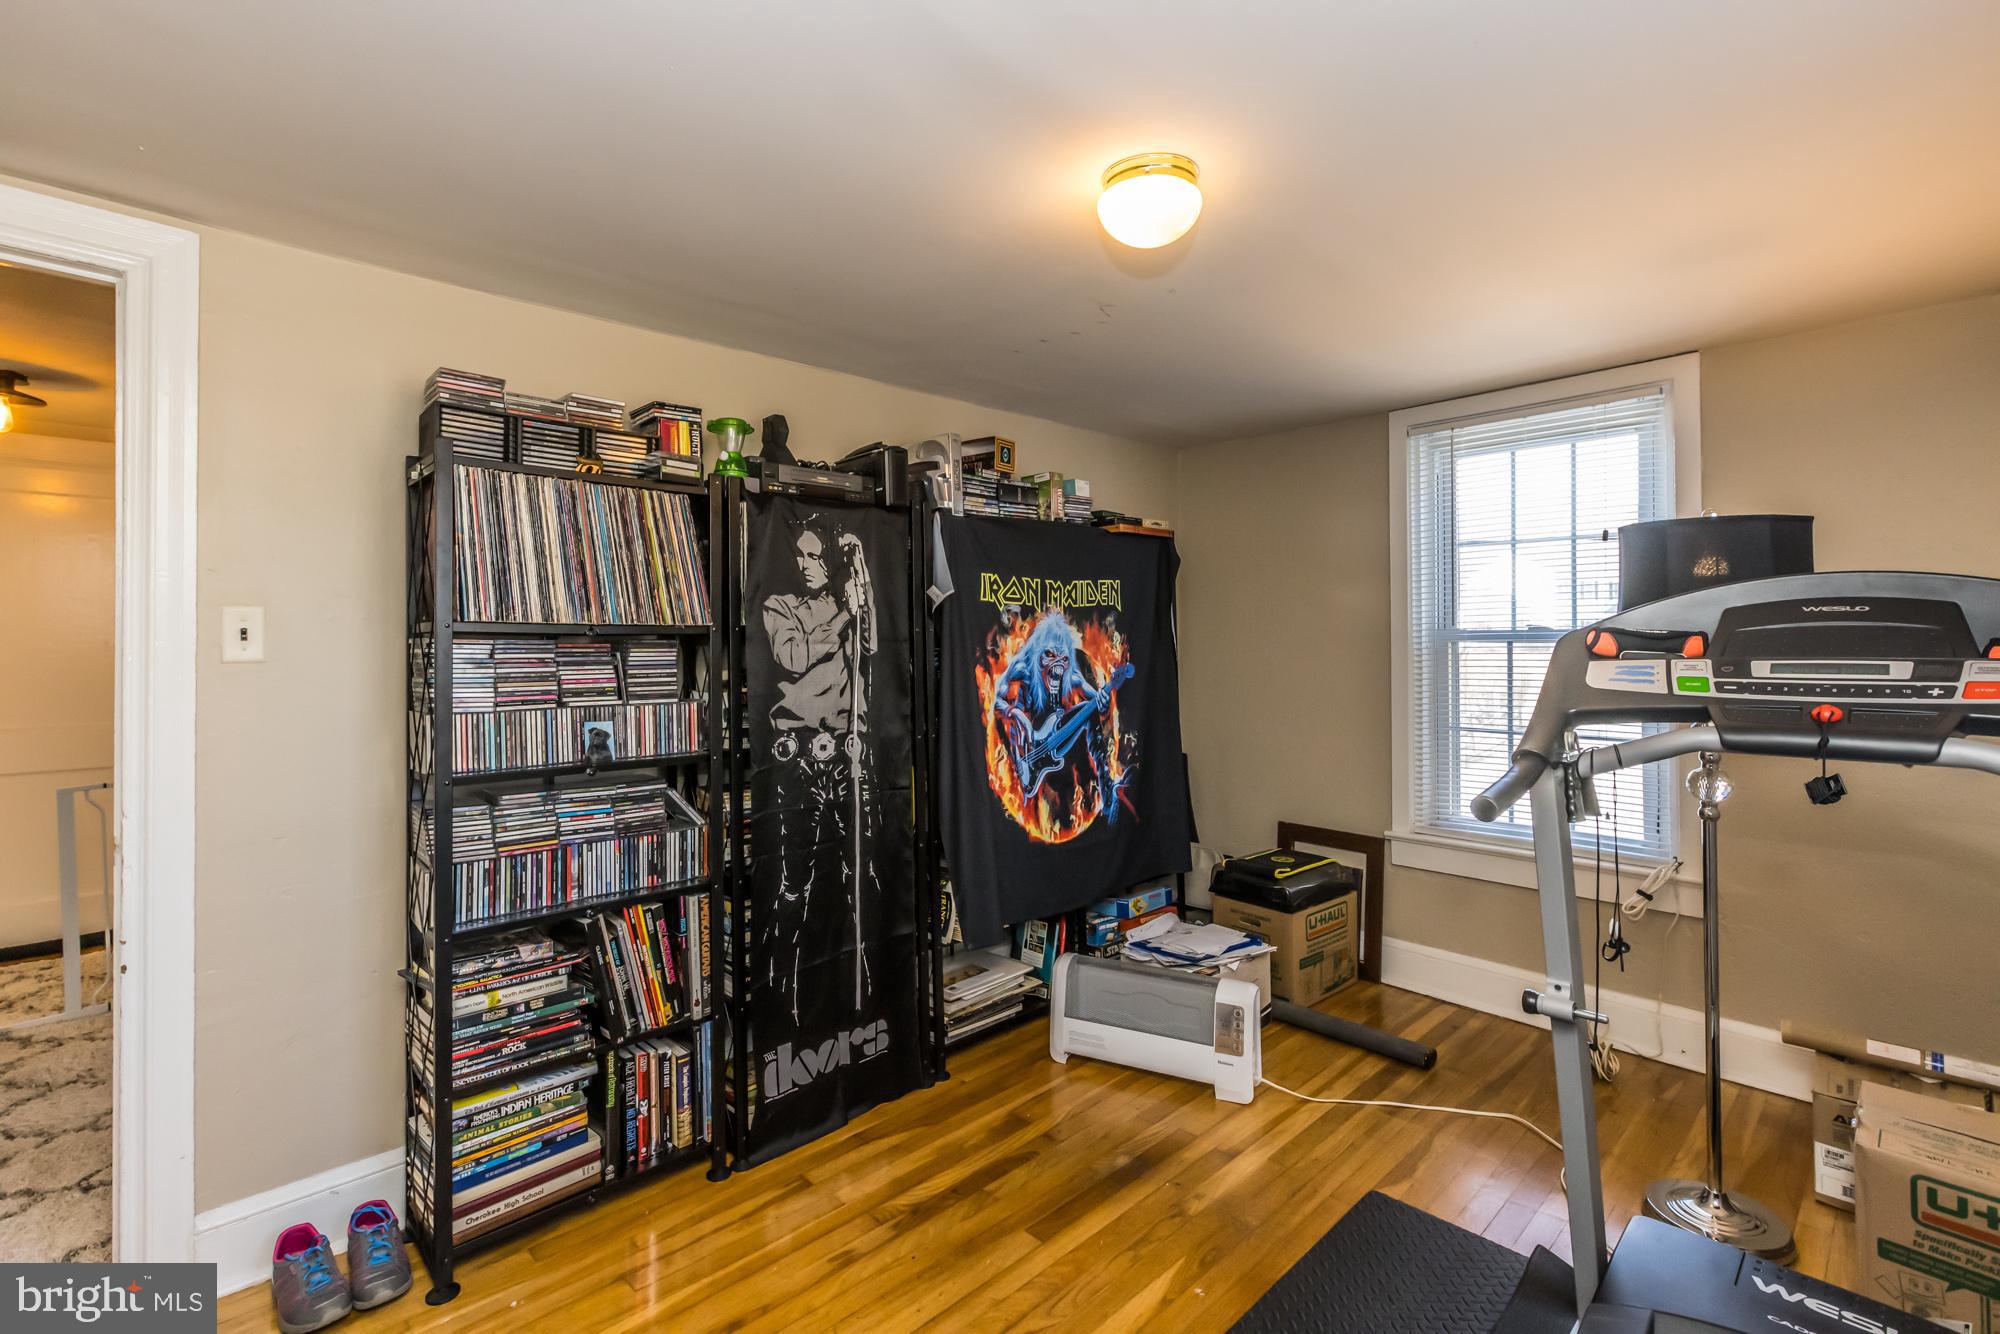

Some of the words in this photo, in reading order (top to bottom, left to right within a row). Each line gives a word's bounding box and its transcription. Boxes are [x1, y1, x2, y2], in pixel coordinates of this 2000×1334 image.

[980, 572, 1041, 612] IRON
[1045, 579, 1122, 613] MAIDEN
[1309, 907, 1346, 930] U-HAUL
[529, 971, 553, 980] HORROR
[502, 990, 518, 999] North
[518, 984, 544, 996] American
[501, 1041, 527, 1056] ROCK
[763, 1050, 777, 1062] THE
[452, 1069, 501, 1088] ENCYCLOPEDIA
[502, 1066, 511, 1074] OF
[512, 1060, 529, 1070] ROCK
[625, 1061, 635, 1076] ACE
[500, 1098, 532, 1117] INDIAN
[533, 1083, 574, 1104] HERITAGE
[625, 1076, 635, 1106] FREHLEY
[459, 1124, 496, 1141] ANIMAL
[499, 1111, 533, 1128] STORIES
[626, 1107, 636, 1120] NO
[626, 1121, 636, 1152] REGRETS
[465, 1207, 501, 1225] Cherokee
[503, 1198, 519, 1210] High
[522, 1188, 544, 1203] School
[1912, 1240, 1925, 1250] to
[1927, 1244, 1962, 1262] Make
[1914, 1229, 1987, 1261] Specifically
